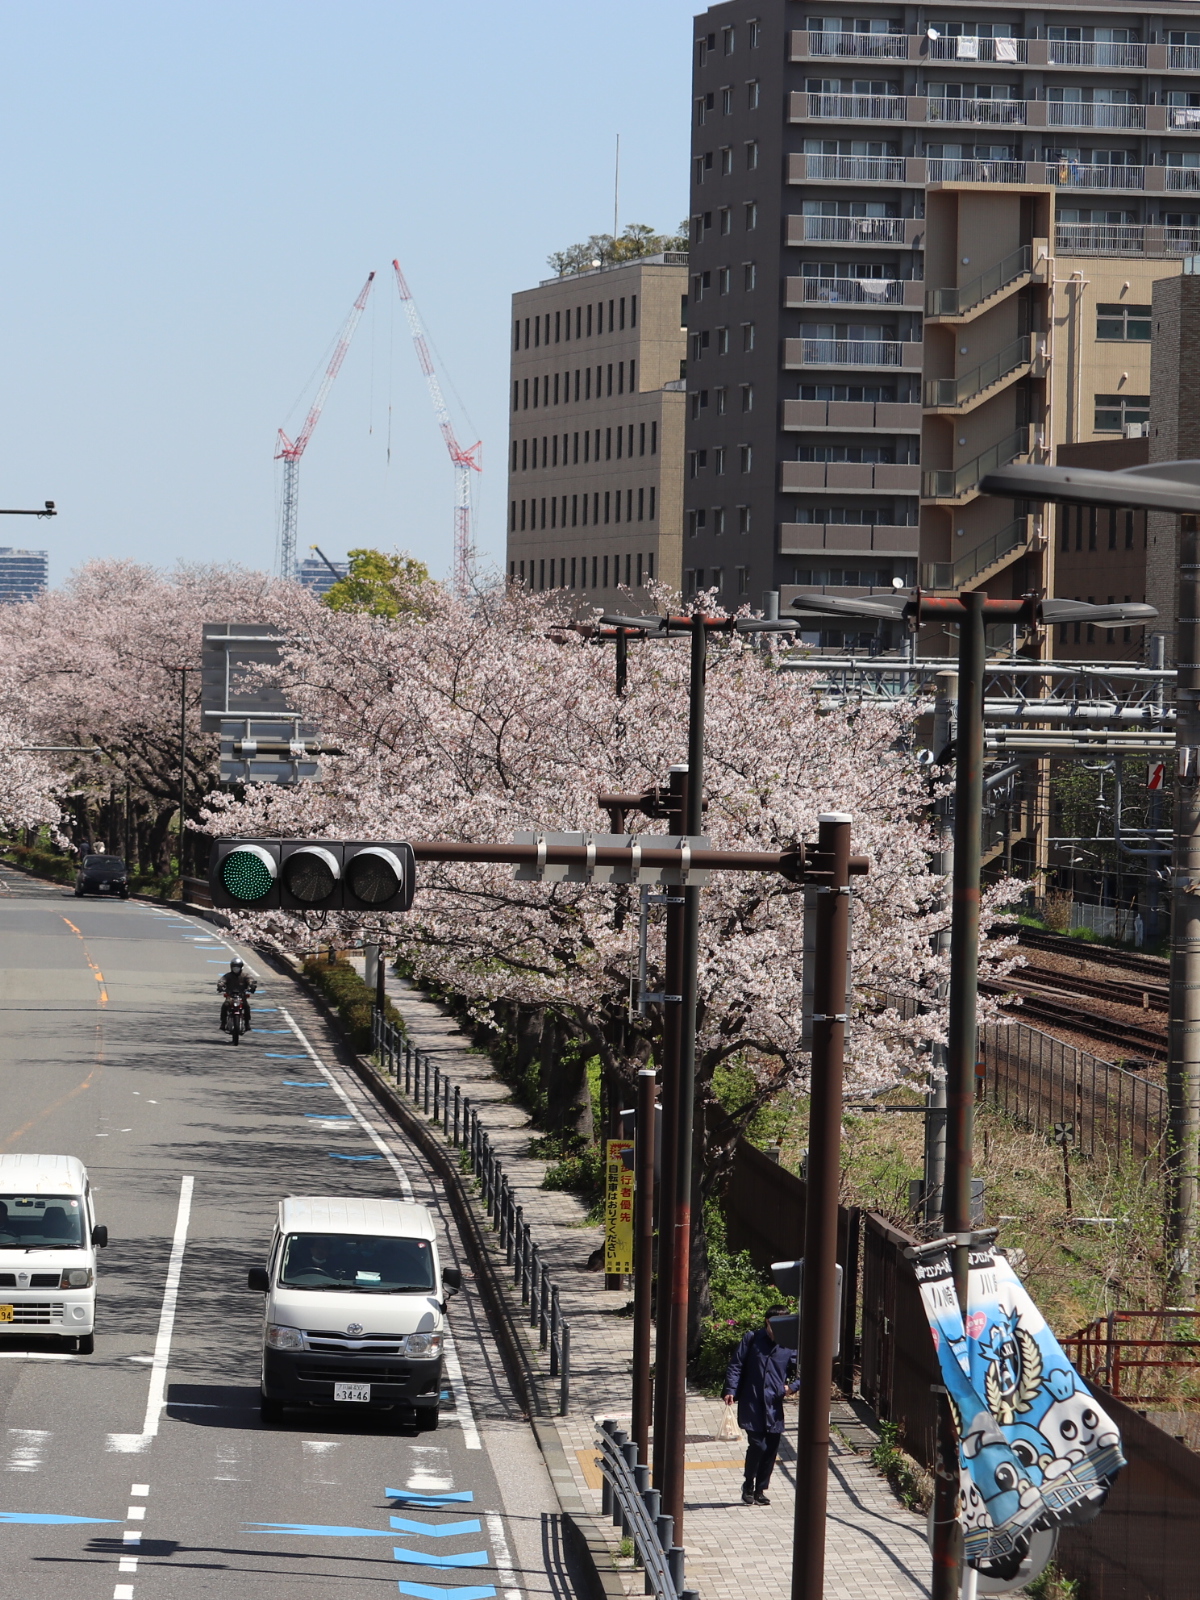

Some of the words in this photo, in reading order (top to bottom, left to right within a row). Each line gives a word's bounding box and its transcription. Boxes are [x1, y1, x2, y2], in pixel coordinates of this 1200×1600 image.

[607, 1164, 618, 1259] 自転車はおりてください
[341, 1390, 368, 1401] 34-46
